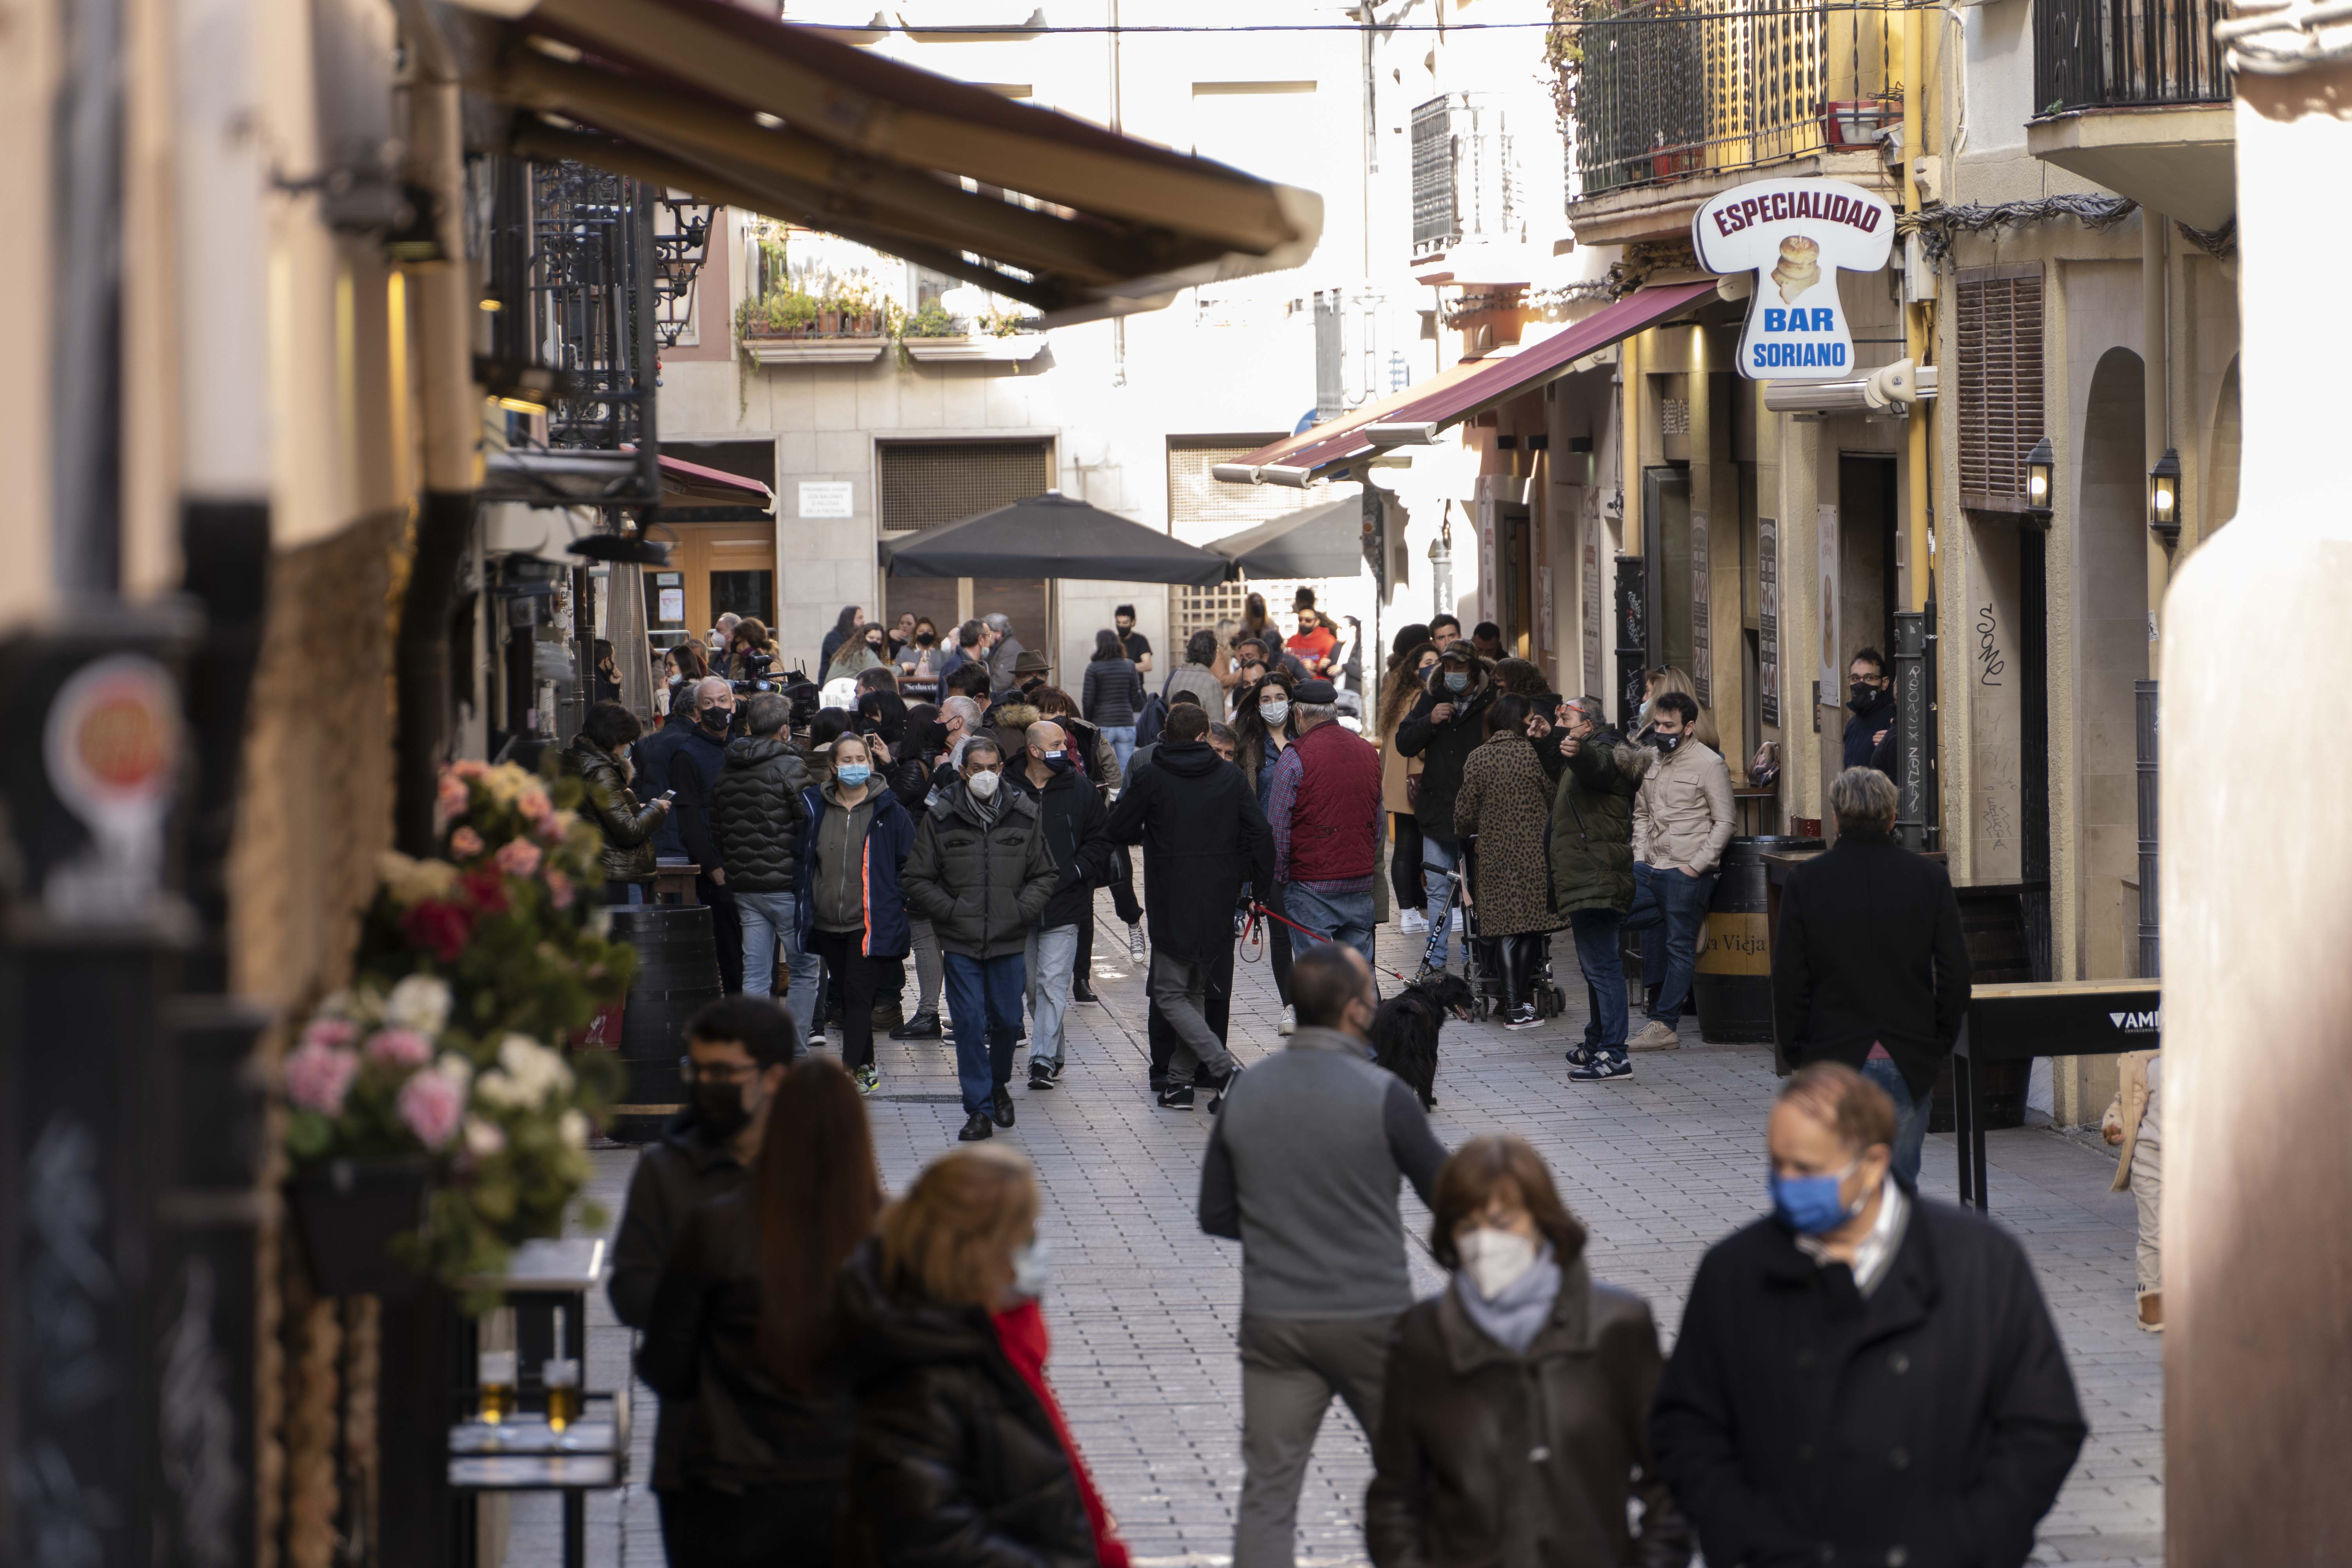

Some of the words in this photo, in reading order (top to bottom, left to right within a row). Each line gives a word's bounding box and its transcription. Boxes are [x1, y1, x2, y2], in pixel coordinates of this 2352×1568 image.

[1713, 191, 1882, 237] ESPECIALIDAD
[1764, 308, 1834, 332] BAR
[1753, 342, 1845, 367] SORIANO
[1722, 935, 1766, 955] Vieja
